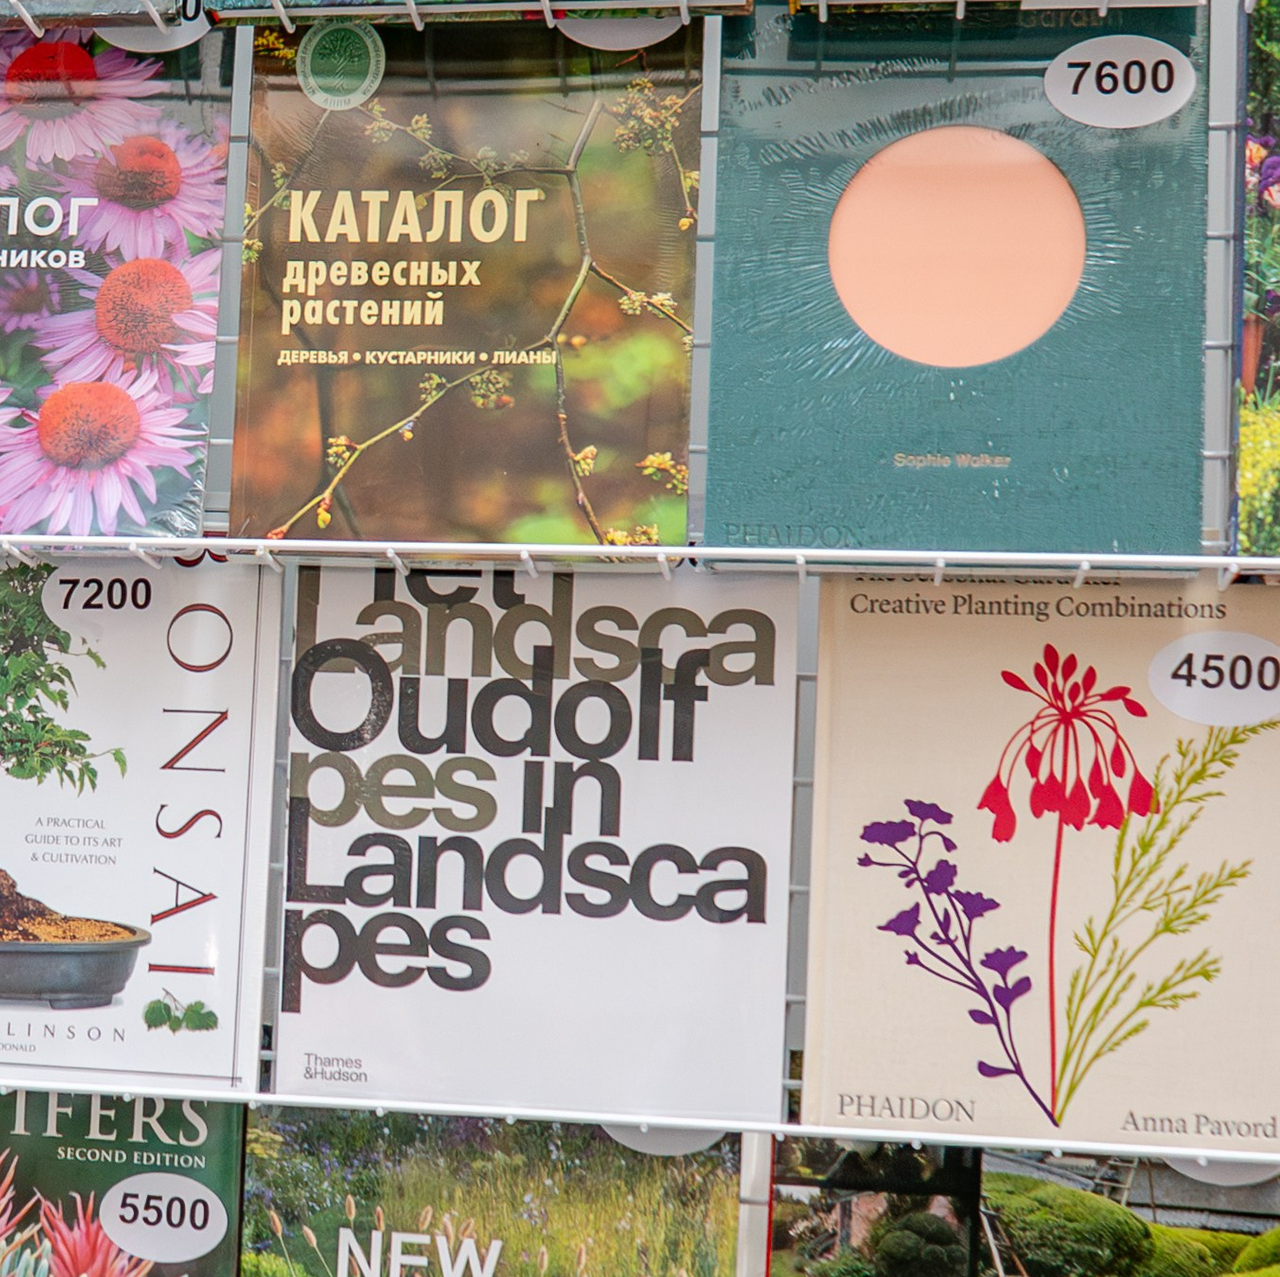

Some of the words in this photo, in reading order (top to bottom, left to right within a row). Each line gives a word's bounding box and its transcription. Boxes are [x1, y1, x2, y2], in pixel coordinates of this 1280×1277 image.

[1067, 59, 1175, 96] 7600
[288, 189, 545, 243] КАТАЛОГ
[282, 259, 482, 296] древесных
[281, 292, 445, 335] растений
[277, 349, 349, 366] ДЕРЕВЬЯ
[365, 350, 476, 366] КУСТАРНИКИ
[491, 349, 558, 365] ЛИАНЫ
[59, 577, 153, 610] 7200
[850, 594, 946, 616] Creative
[952, 595, 1050, 622] Planting
[1056, 596, 1226, 620] Combinations
[295, 565, 776, 686] Landsca
[1171, 653, 1280, 690] 4500
[291, 638, 710, 762] Oudolf
[304, 1053, 363, 1069] Thames
[304, 1067, 368, 1083] &Hudson
[119, 1193, 210, 1230] 5500
